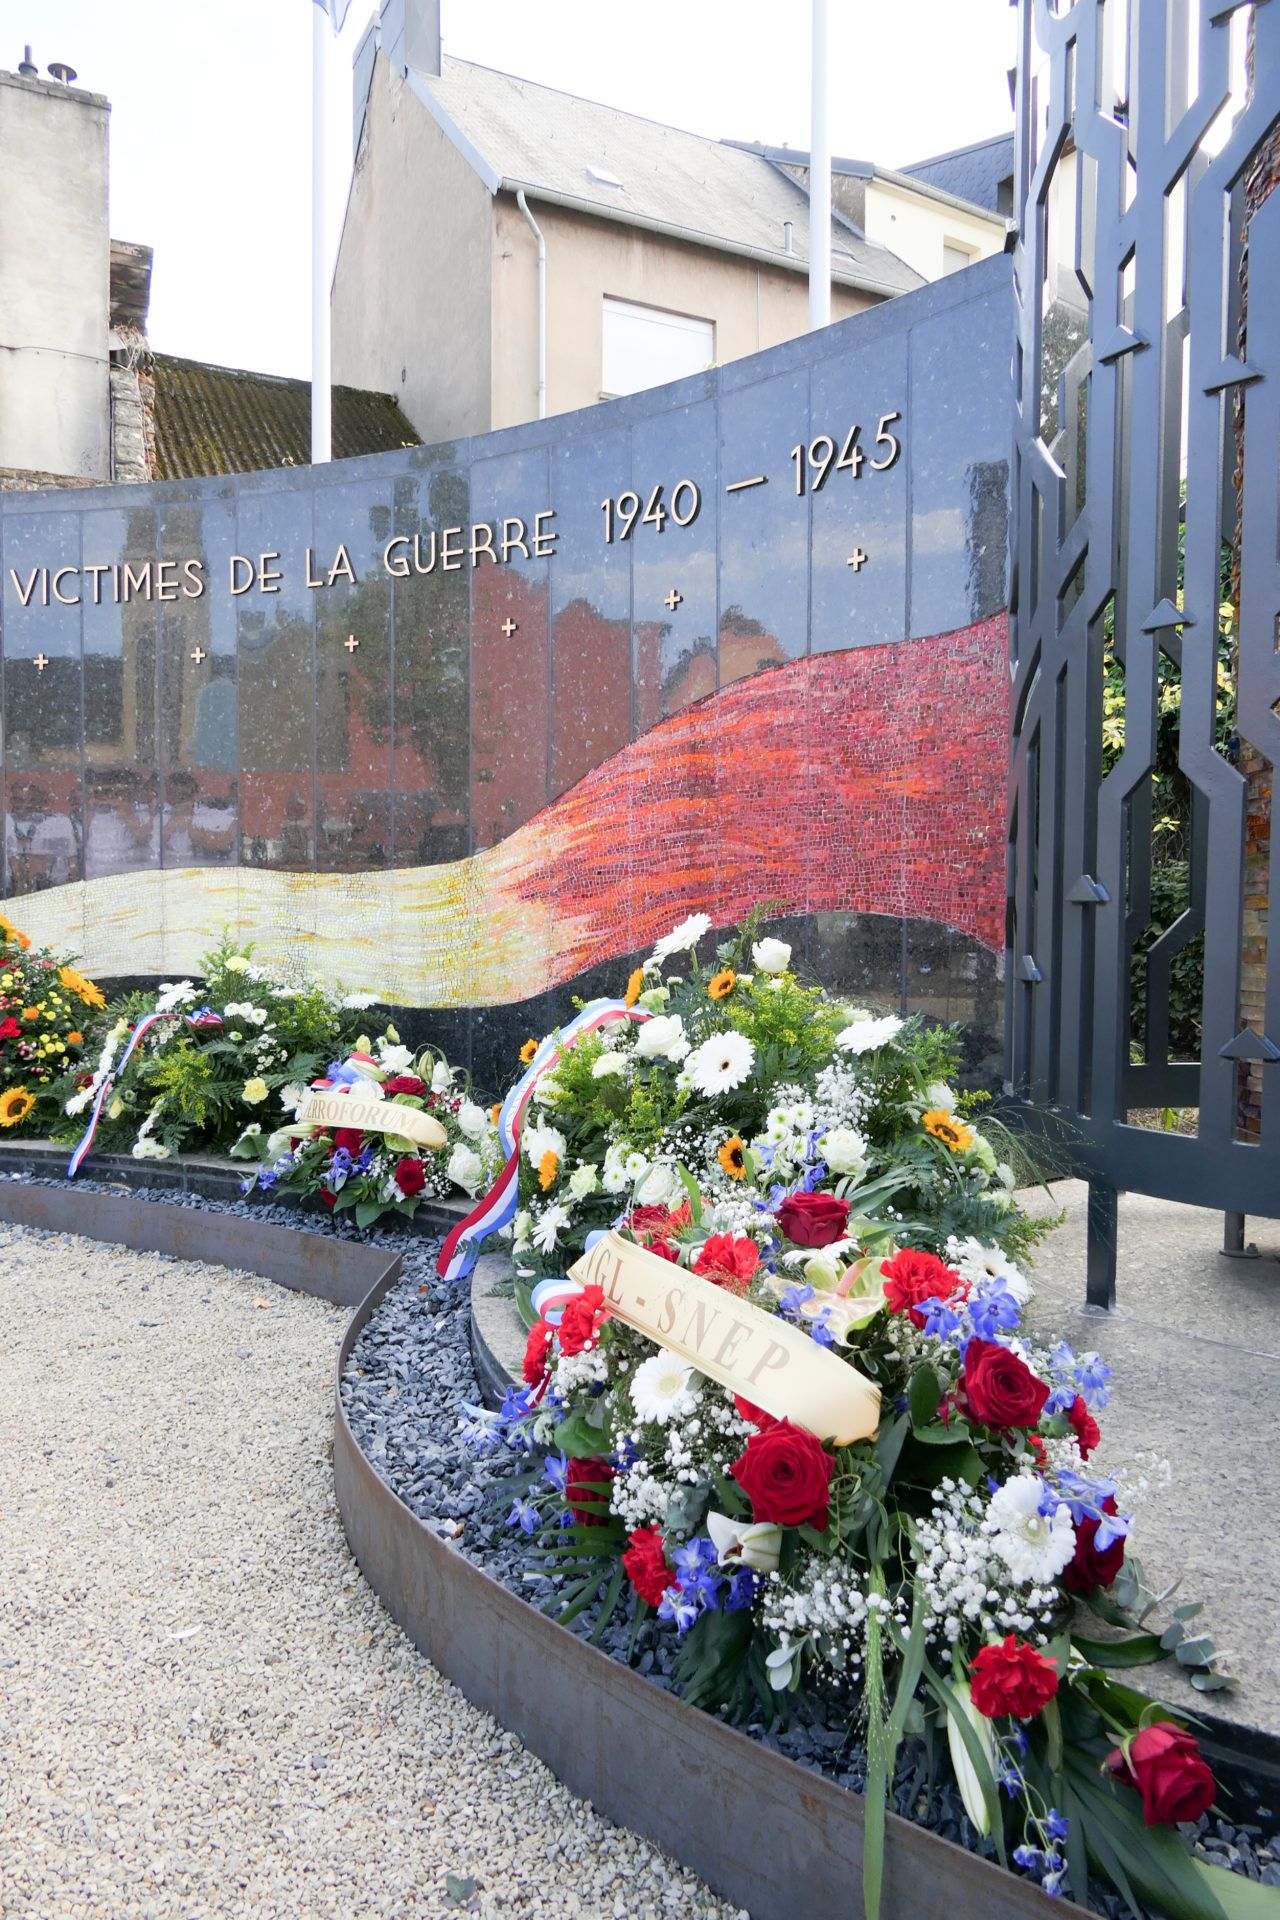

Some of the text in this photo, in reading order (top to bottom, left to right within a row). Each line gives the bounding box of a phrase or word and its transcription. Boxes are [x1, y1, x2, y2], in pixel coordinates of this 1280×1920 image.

[10, 559, 205, 606] VICTIMES
[229, 552, 281, 595] DE
[305, 544, 356, 588] LA
[383, 510, 557, 577] GUERRE
[601, 478, 700, 543] 1940
[790, 411, 901, 495] 1945
[656, 1286, 791, 1387] SNEP
